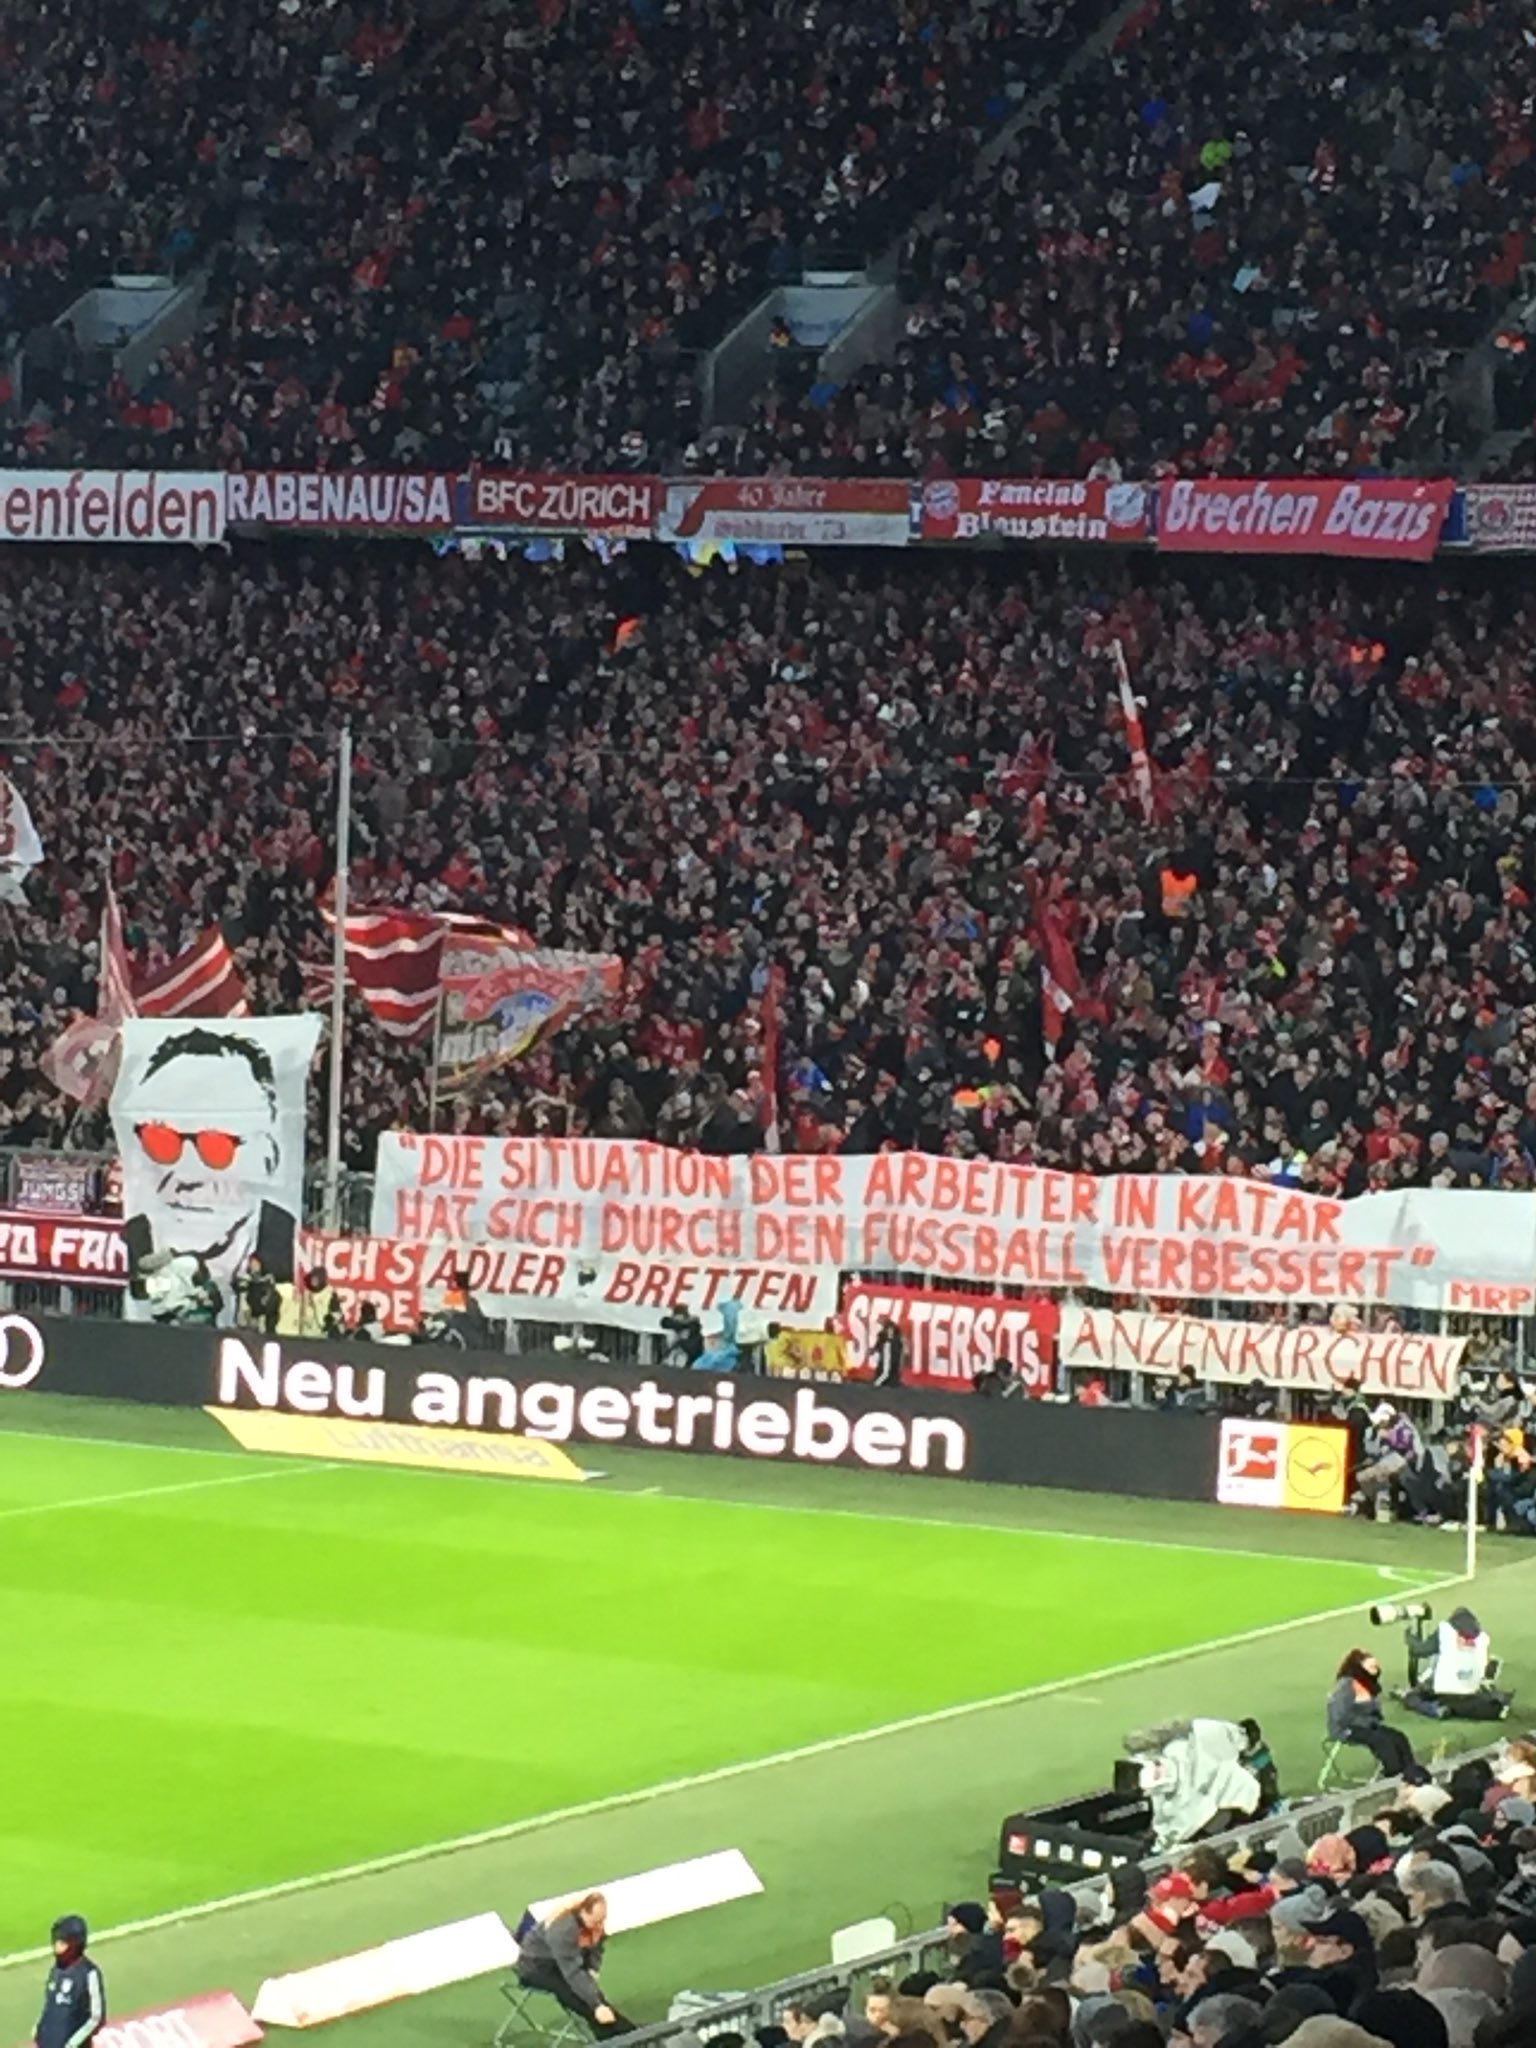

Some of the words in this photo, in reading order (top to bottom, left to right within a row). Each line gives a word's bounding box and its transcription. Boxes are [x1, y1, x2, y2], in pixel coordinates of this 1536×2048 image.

[228, 474, 453, 523] RABENAU/SA
[477, 479, 537, 517] BFC
[538, 479, 651, 520] ZÜRICH
[978, 480, 1087, 506] Fanclub
[1163, 480, 1318, 535] Brechen
[1322, 484, 1437, 542] Bazis
[400, 1135, 485, 1189] "DIE
[500, 1140, 731, 1198] SITUATION
[749, 1153, 844, 1206] DER
[864, 1152, 1100, 1225] ARBEITER
[1114, 1176, 1158, 1229] IN
[1178, 1179, 1342, 1244] KATAR
[396, 1189, 477, 1241] HAT
[487, 1198, 583, 1248] SICH
[600, 1203, 743, 1258] DURCH
[754, 1213, 845, 1265] DEN
[862, 1212, 1087, 1283] FUSSBALL
[1100, 1235, 1436, 1299] VERBESSERT"
[428, 1247, 568, 1298] ADLER
[604, 1259, 818, 1314] BRETTEN
[1451, 1281, 1533, 1312] MRP
[1069, 1307, 1455, 1396] ANZENKIRCHEN
[217, 1337, 386, 1417] Neu
[411, 1371, 966, 1472] angetrieben
